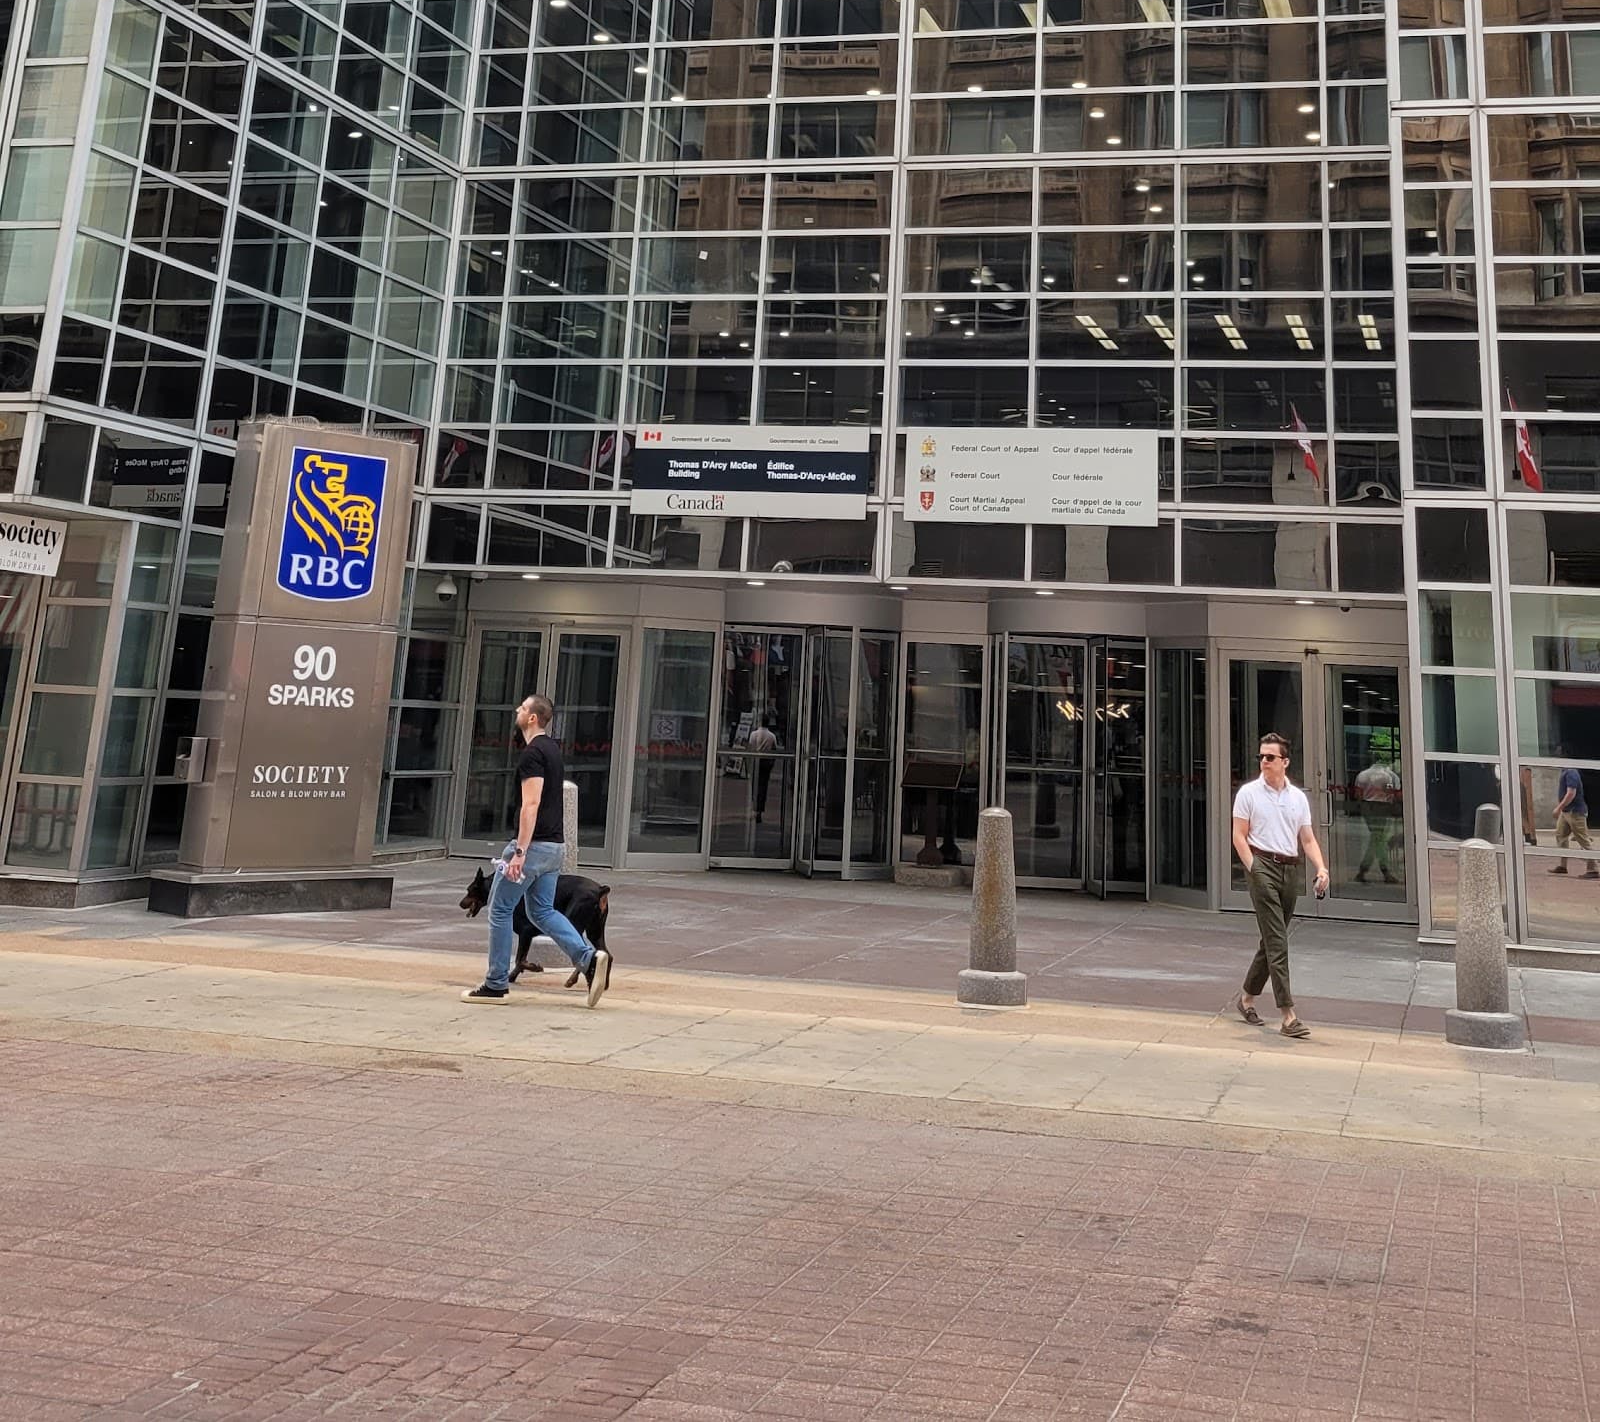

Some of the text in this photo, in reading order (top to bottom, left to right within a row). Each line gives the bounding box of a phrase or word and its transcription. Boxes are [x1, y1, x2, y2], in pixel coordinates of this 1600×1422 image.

[1073, 446, 1100, 454] d'appel
[1103, 446, 1133, 454] fédérale
[668, 460, 758, 471] Thomas D'Arcy McGee
[767, 460, 795, 470] Édifice
[668, 469, 700, 479] Building
[766, 471, 857, 482] Thomas-D'Arcy-McGee
[979, 472, 1000, 480] Court
[1052, 473, 1103, 481] Cour fédérale
[667, 493, 724, 511] Canada
[972, 496, 997, 504] Martial
[1000, 497, 1026, 505] Appeal
[1072, 498, 1100, 506] d'appel
[949, 504, 969, 512] Court
[1096, 507, 1126, 515] Canada
[0, 519, 61, 555] society
[9, 549, 32, 558] SALON
[18, 561, 32, 570] DRY
[289, 553, 365, 590] RBC
[293, 644, 337, 681] 90
[268, 683, 354, 708] SPARKS
[252, 765, 350, 784] SOCIETY
[250, 790, 346, 798] SALON & BLOW DRY BAR
